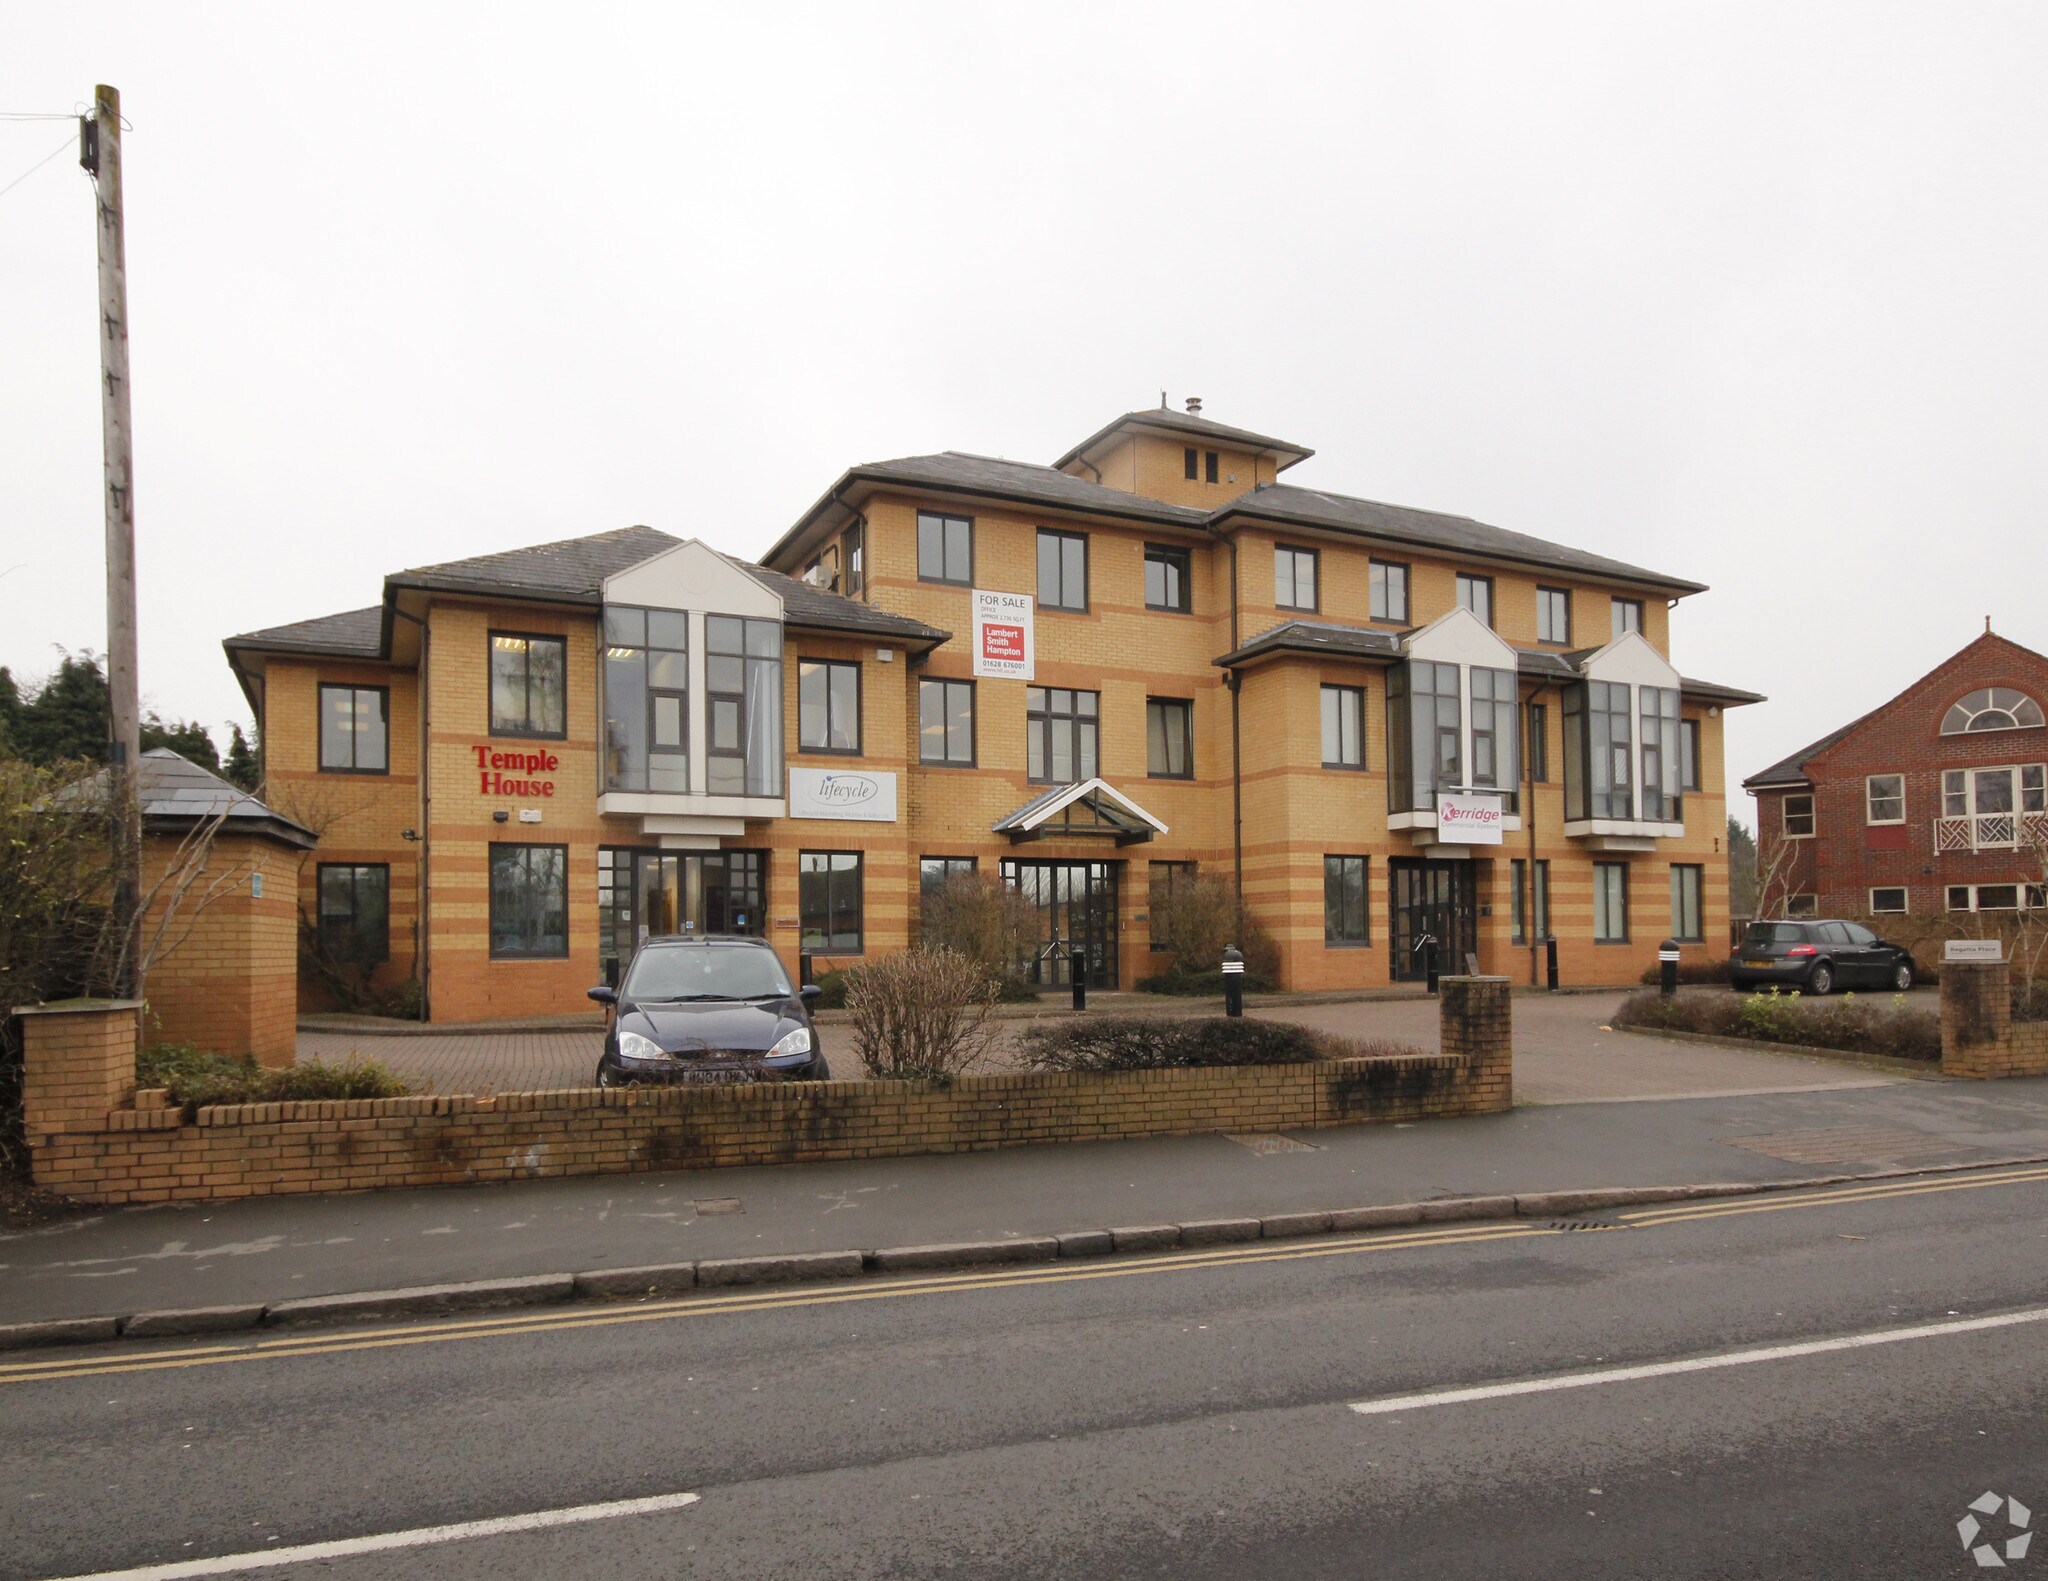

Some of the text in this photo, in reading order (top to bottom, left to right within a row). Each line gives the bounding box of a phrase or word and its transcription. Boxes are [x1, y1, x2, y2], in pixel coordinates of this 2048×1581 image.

[980, 594, 1025, 609] FOR SALE
[986, 627, 1018, 638] Lambert
[987, 637, 1009, 646] Smith
[987, 646, 1021, 656] Hampton
[983, 660, 1001, 668] 01628
[472, 745, 559, 775] Temple
[480, 771, 554, 797] House
[819, 780, 869, 801] lifecycle
[1441, 802, 1499, 822] Kerridge
